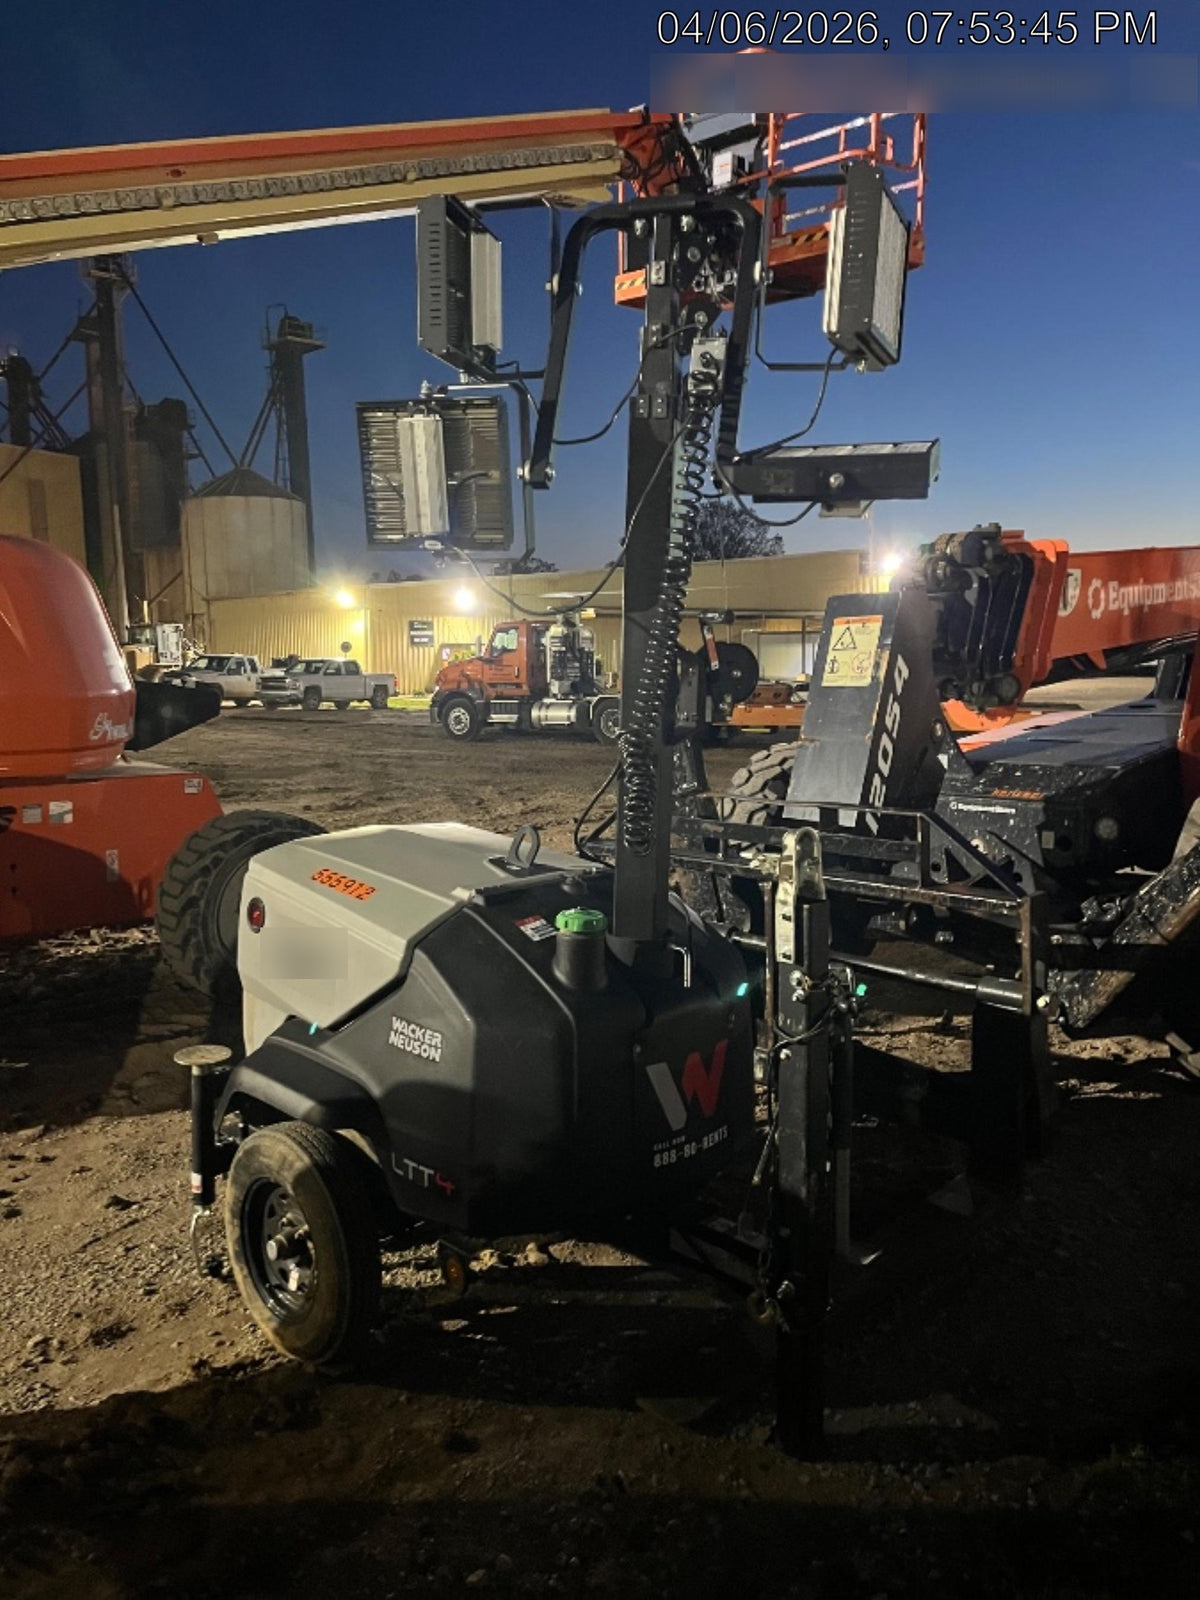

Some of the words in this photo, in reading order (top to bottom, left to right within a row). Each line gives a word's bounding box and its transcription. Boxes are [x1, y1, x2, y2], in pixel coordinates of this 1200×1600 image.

[388, 1030, 442, 1062] NEUSON
[392, 1016, 442, 1048] WACKER
[391, 1152, 455, 1195] LTT4
